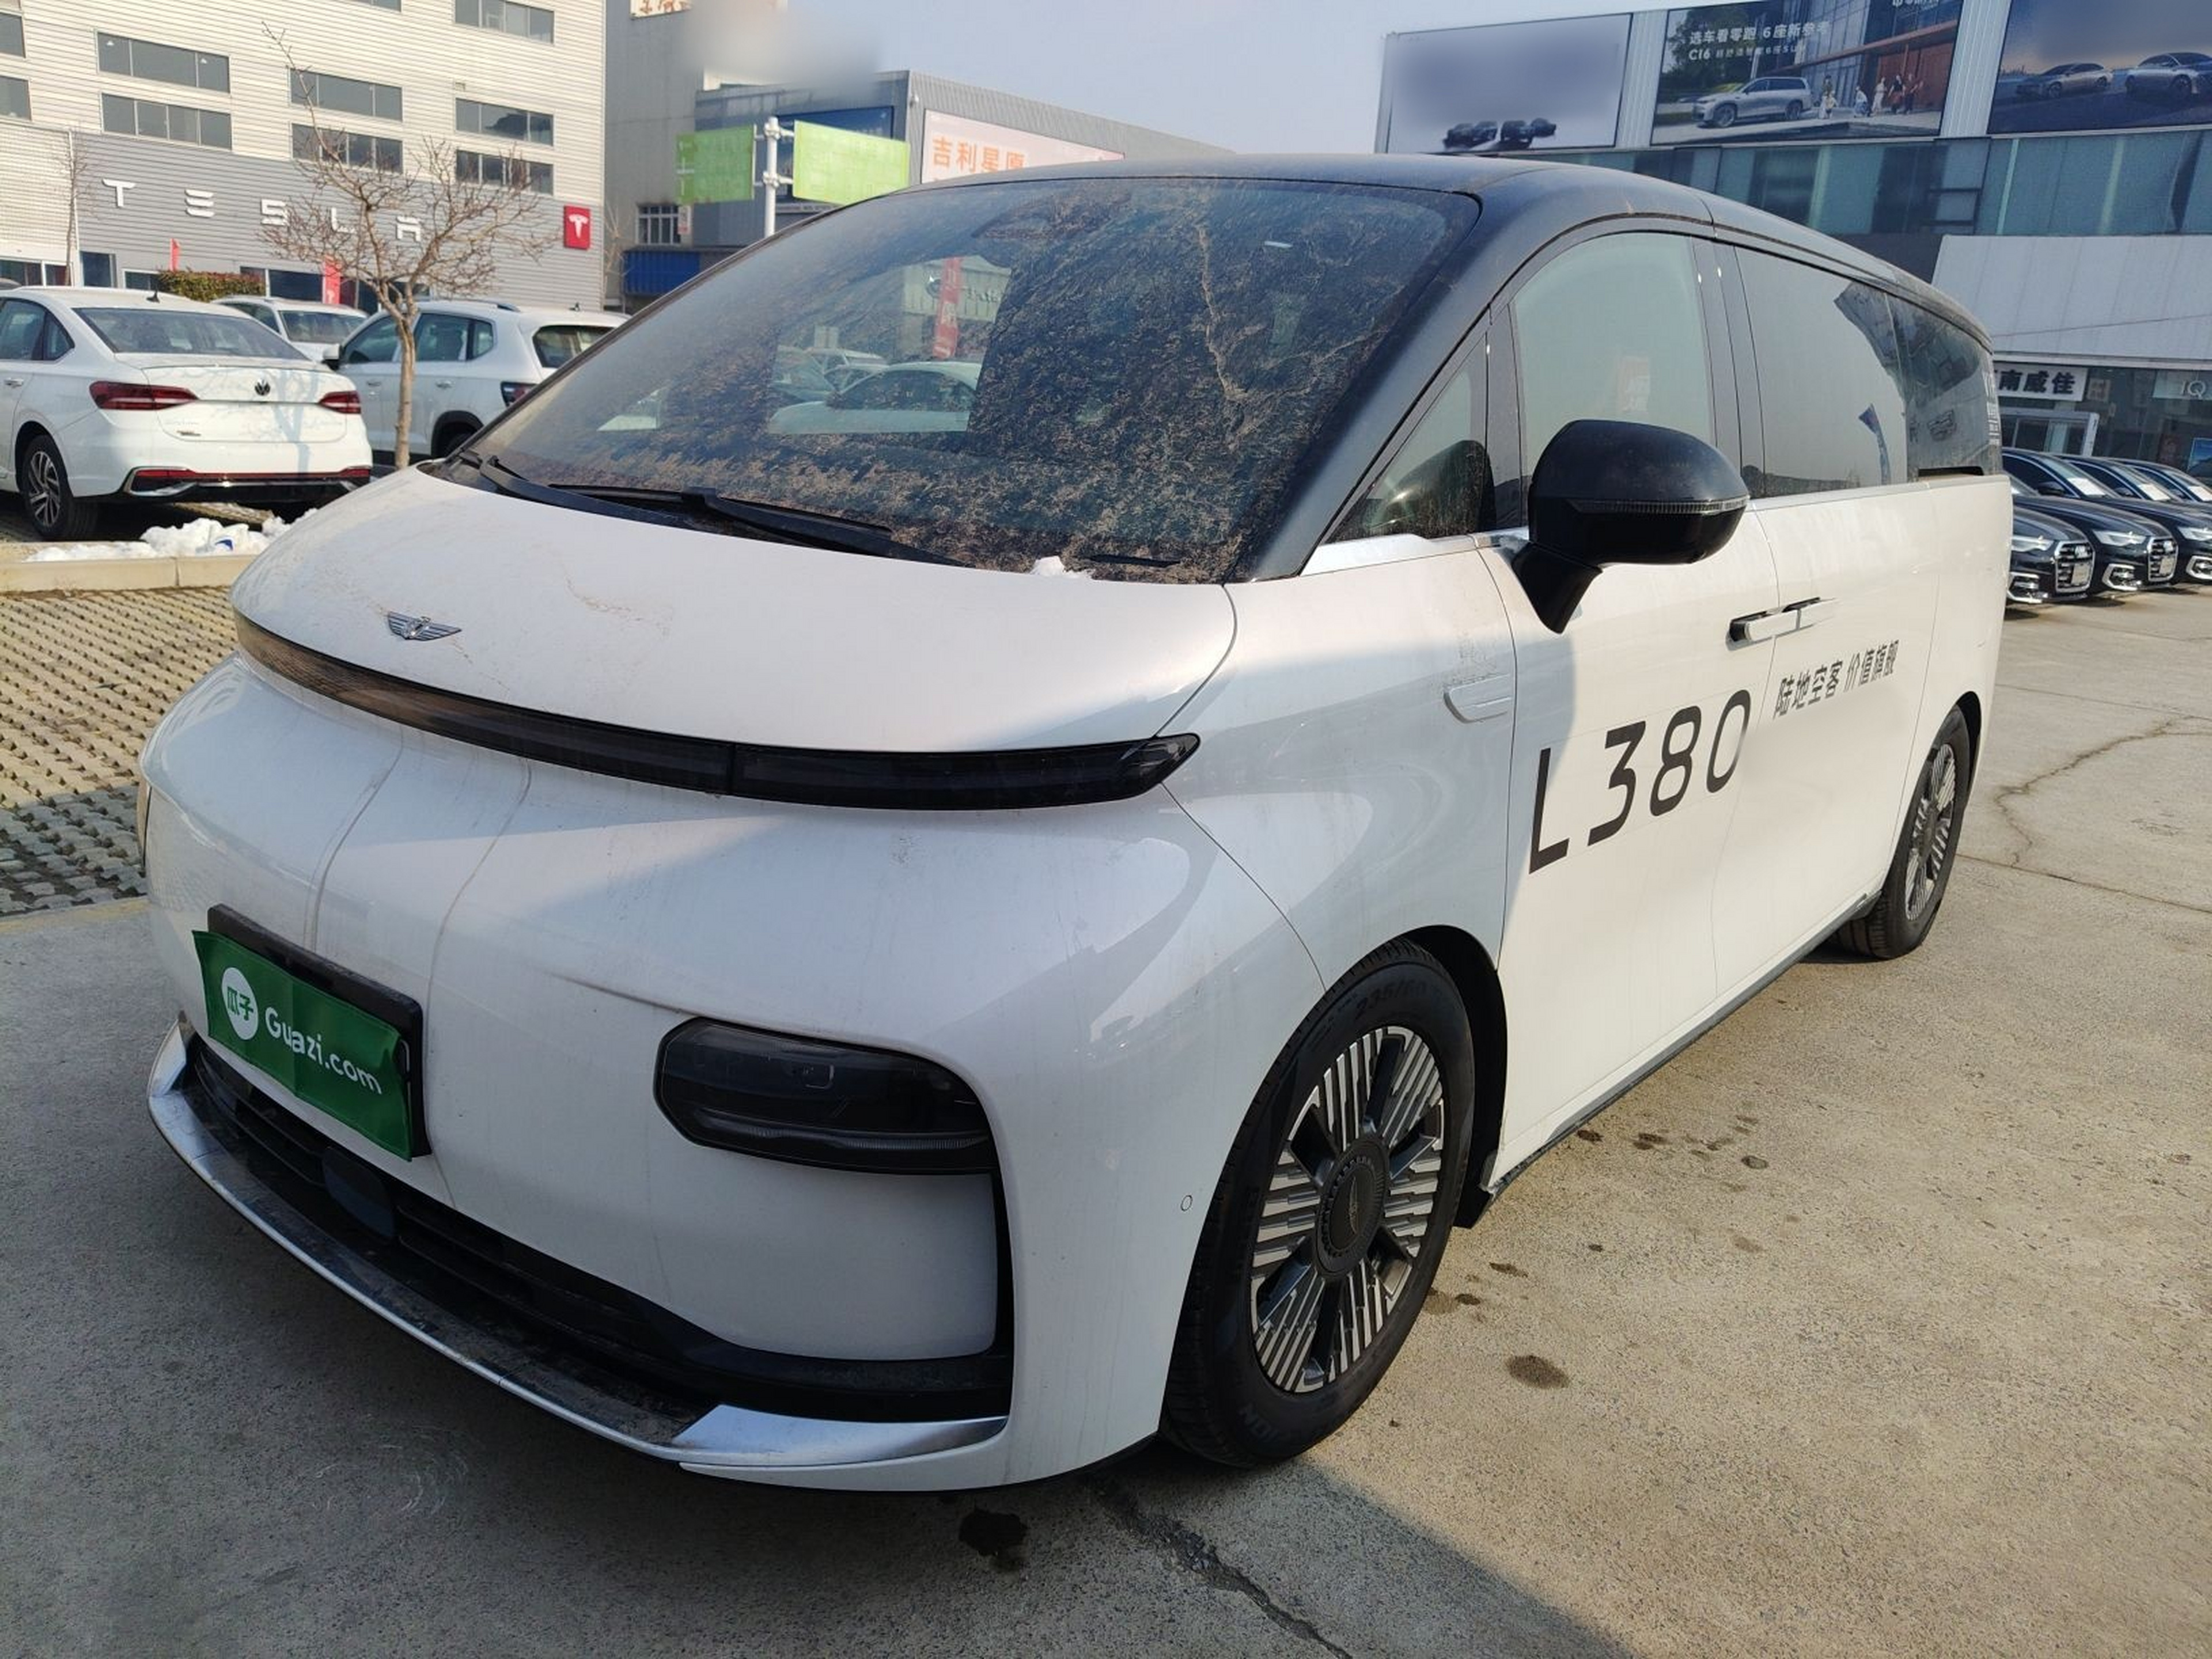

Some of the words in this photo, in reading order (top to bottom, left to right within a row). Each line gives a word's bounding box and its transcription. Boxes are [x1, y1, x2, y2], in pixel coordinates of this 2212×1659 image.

[102, 178, 421, 243] TESLA
[1994, 369, 2075, 395] 南威佳
[1773, 661, 1843, 719] 陆地空客
[1528, 689, 1752, 875] L380
[228, 986, 255, 1021] 瓜子
[265, 1006, 382, 1095] Guazi.com
